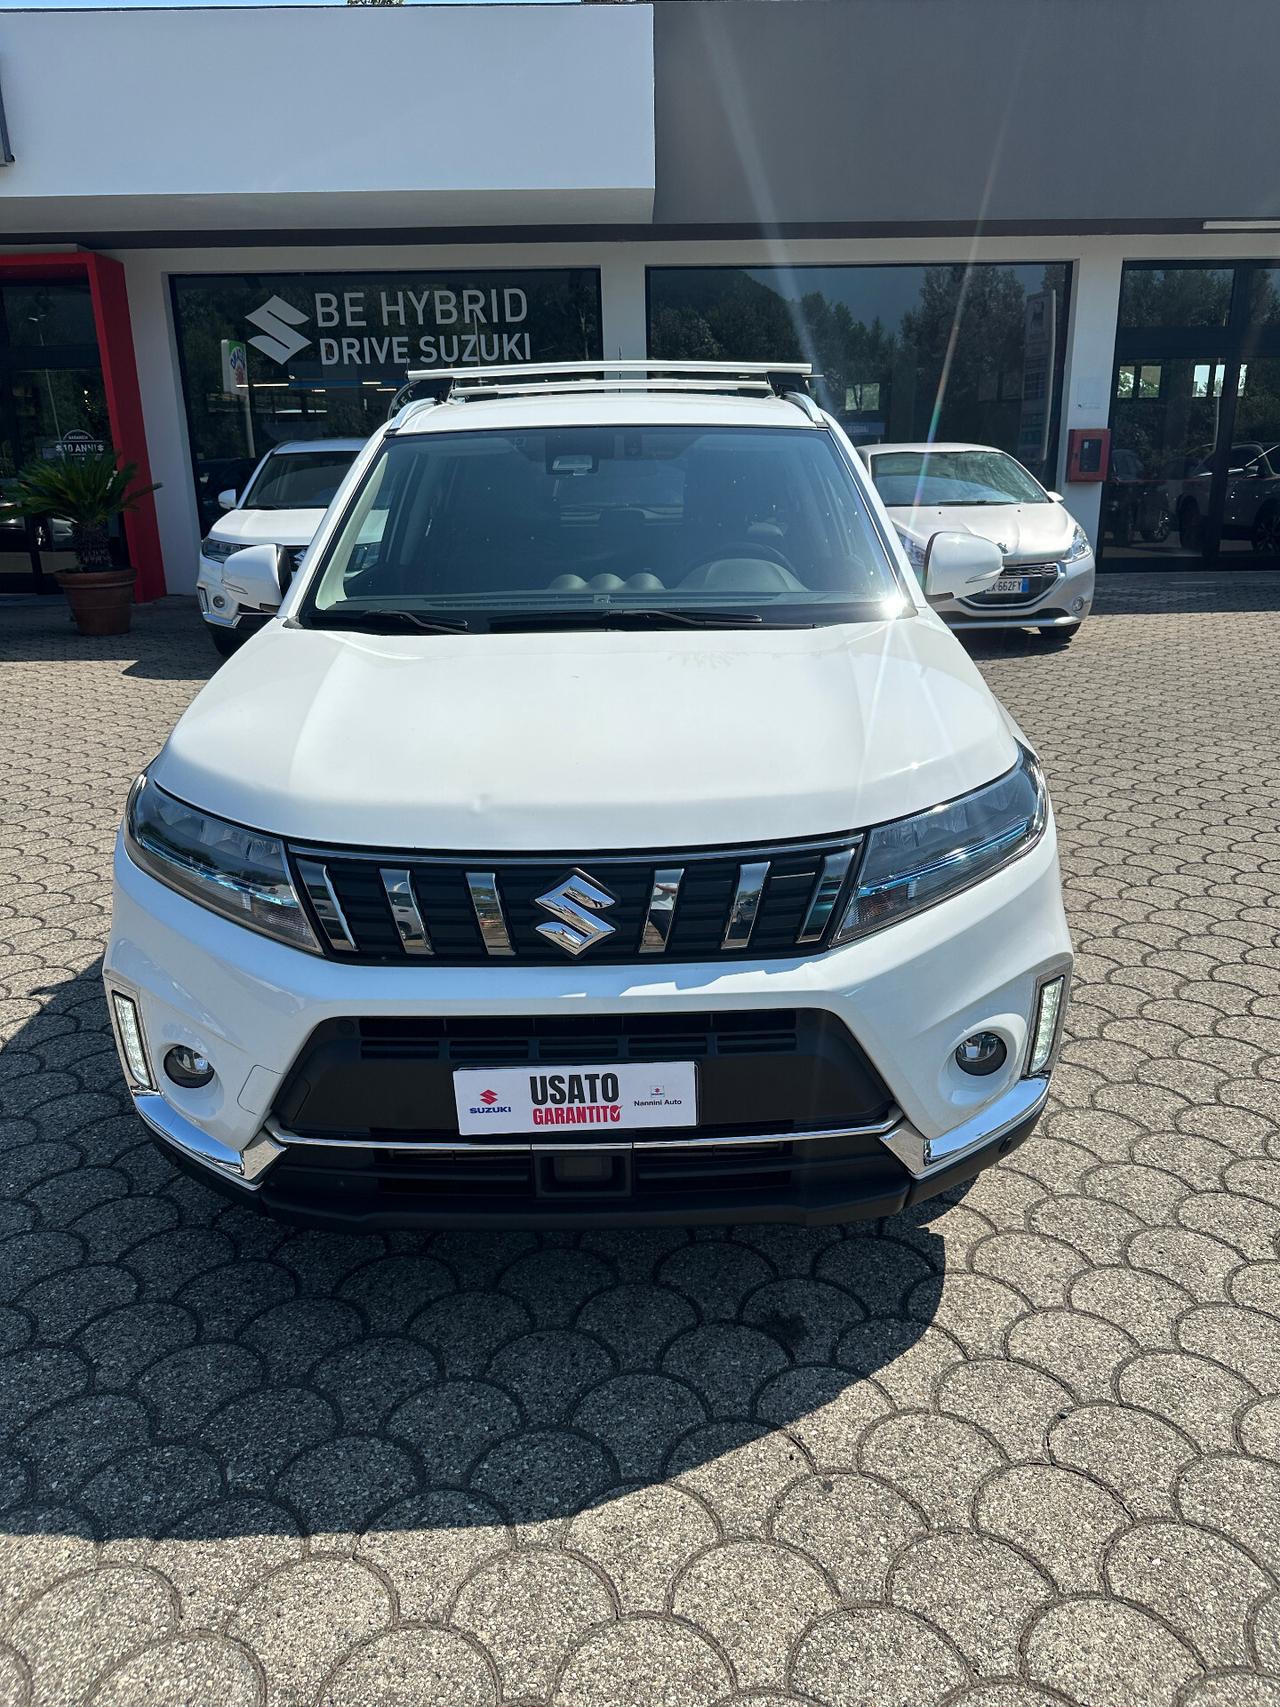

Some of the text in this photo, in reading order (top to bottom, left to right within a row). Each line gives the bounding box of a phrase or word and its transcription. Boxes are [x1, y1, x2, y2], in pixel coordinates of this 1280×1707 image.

[315, 288, 528, 328] BE HYBRID
[319, 333, 532, 366] DRIVE SUZUKI
[63, 443, 73, 453] 10
[530, 1072, 620, 1106] USATO
[469, 1106, 512, 1115] SUZUKI
[634, 1099, 663, 1107] Nannini
[532, 1105, 622, 1126] GARANTITO
